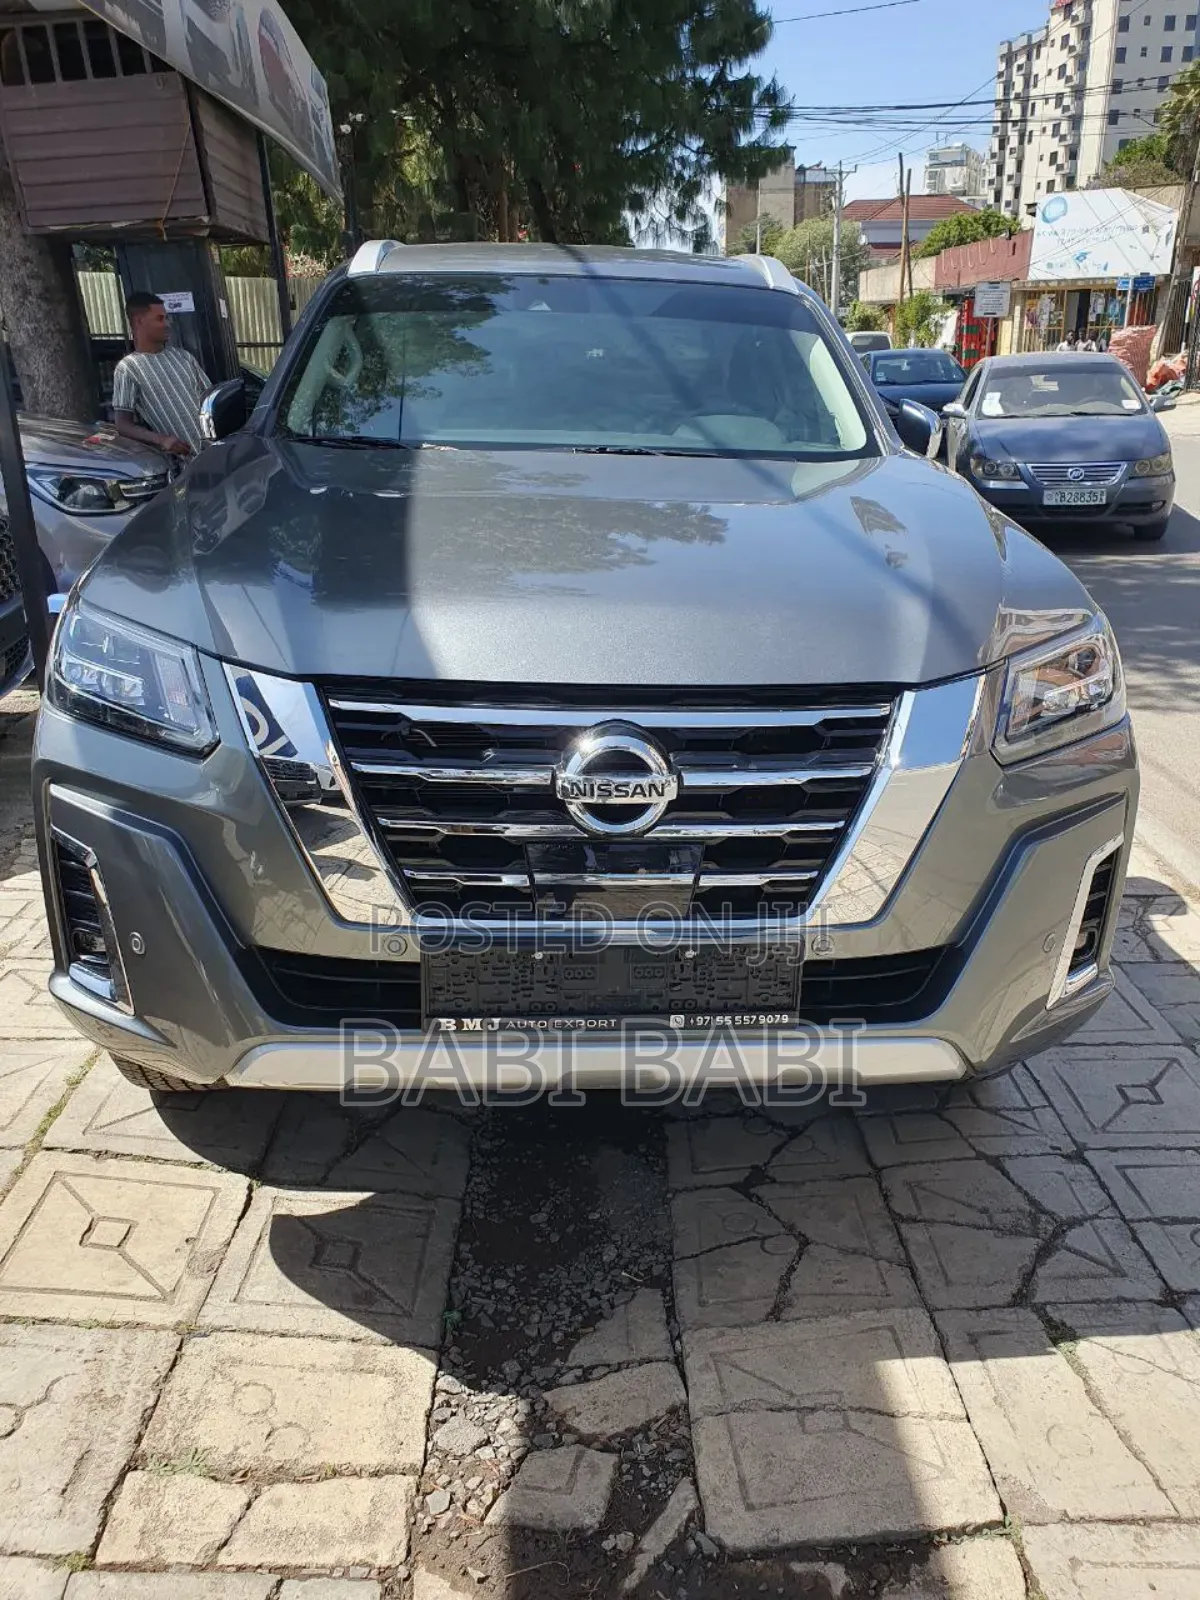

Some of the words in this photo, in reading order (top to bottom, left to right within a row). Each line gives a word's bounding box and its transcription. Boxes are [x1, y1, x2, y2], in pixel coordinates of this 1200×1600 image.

[570, 782, 666, 798] NISSAN
[506, 1020, 547, 1030] AUTO
[554, 1019, 617, 1029] EXPORT
